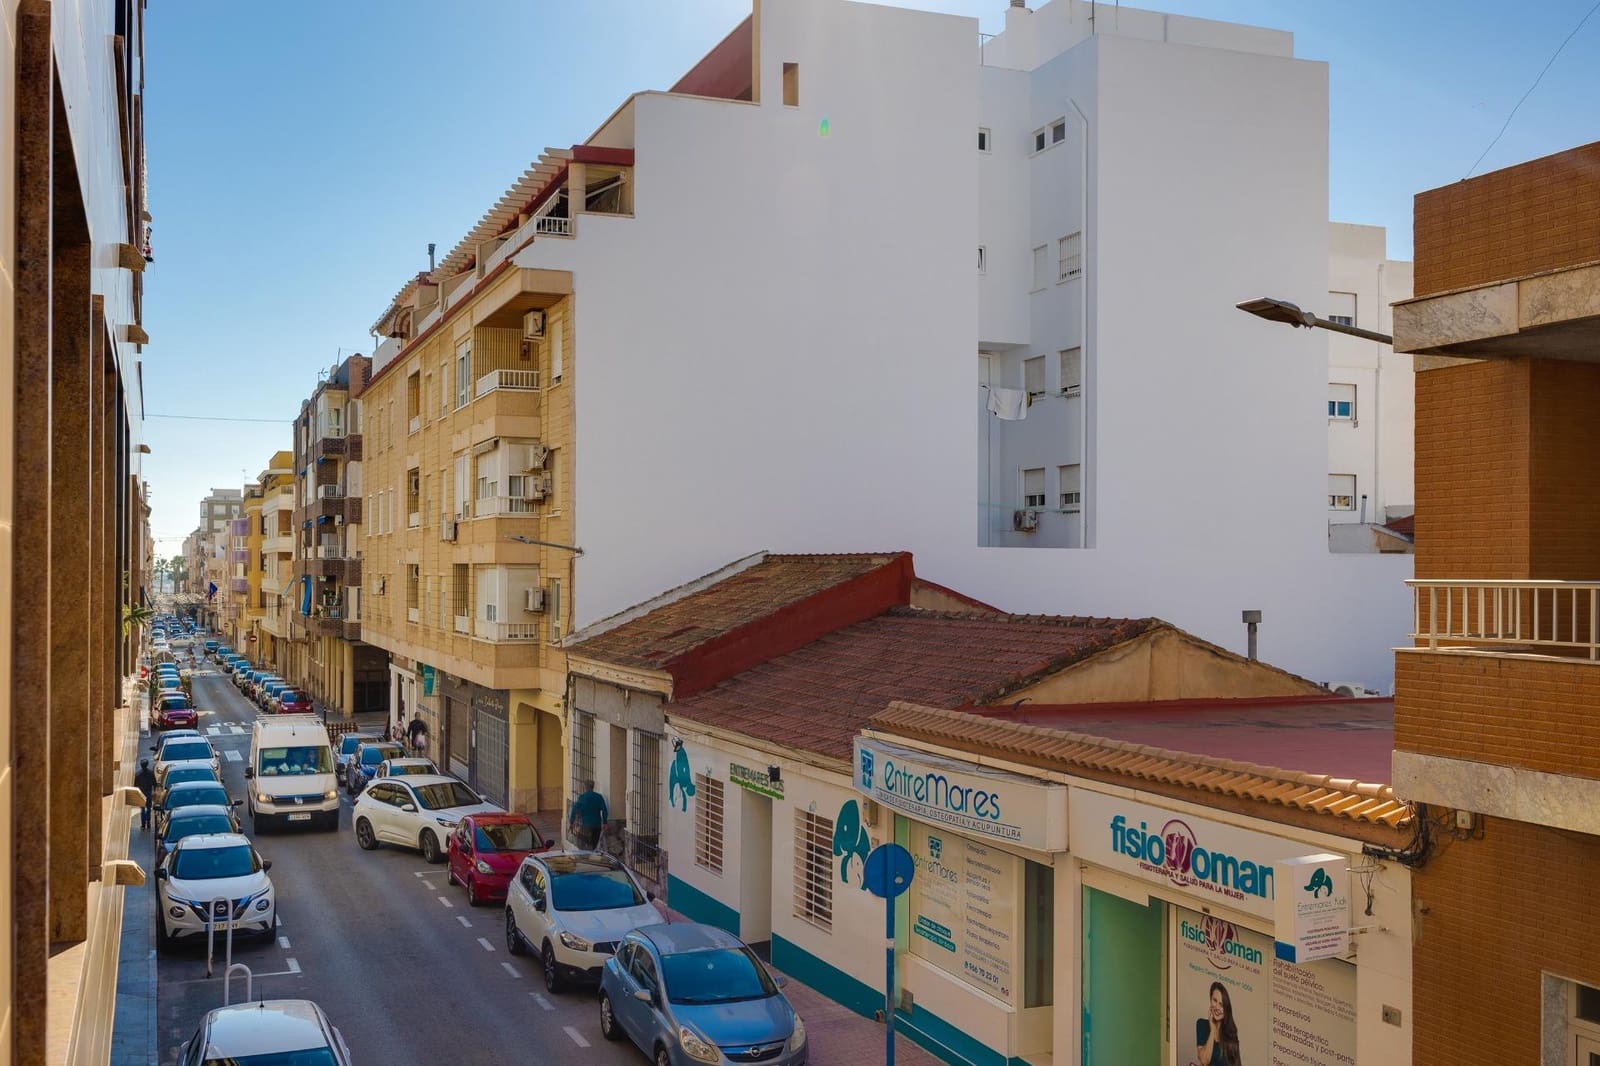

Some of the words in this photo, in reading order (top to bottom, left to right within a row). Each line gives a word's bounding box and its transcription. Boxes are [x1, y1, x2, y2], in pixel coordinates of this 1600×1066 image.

[972, 821, 1021, 838] ACUPUNTURA
[1173, 869, 1179, 879] Y
[1179, 871, 1198, 886] SALUD
[1199, 878, 1213, 890] PARA
[1216, 884, 1223, 894] LA
[1224, 887, 1244, 901] MUJER
[1273, 1017, 1292, 1031] Pilates
[1315, 1042, 1321, 1053] y
